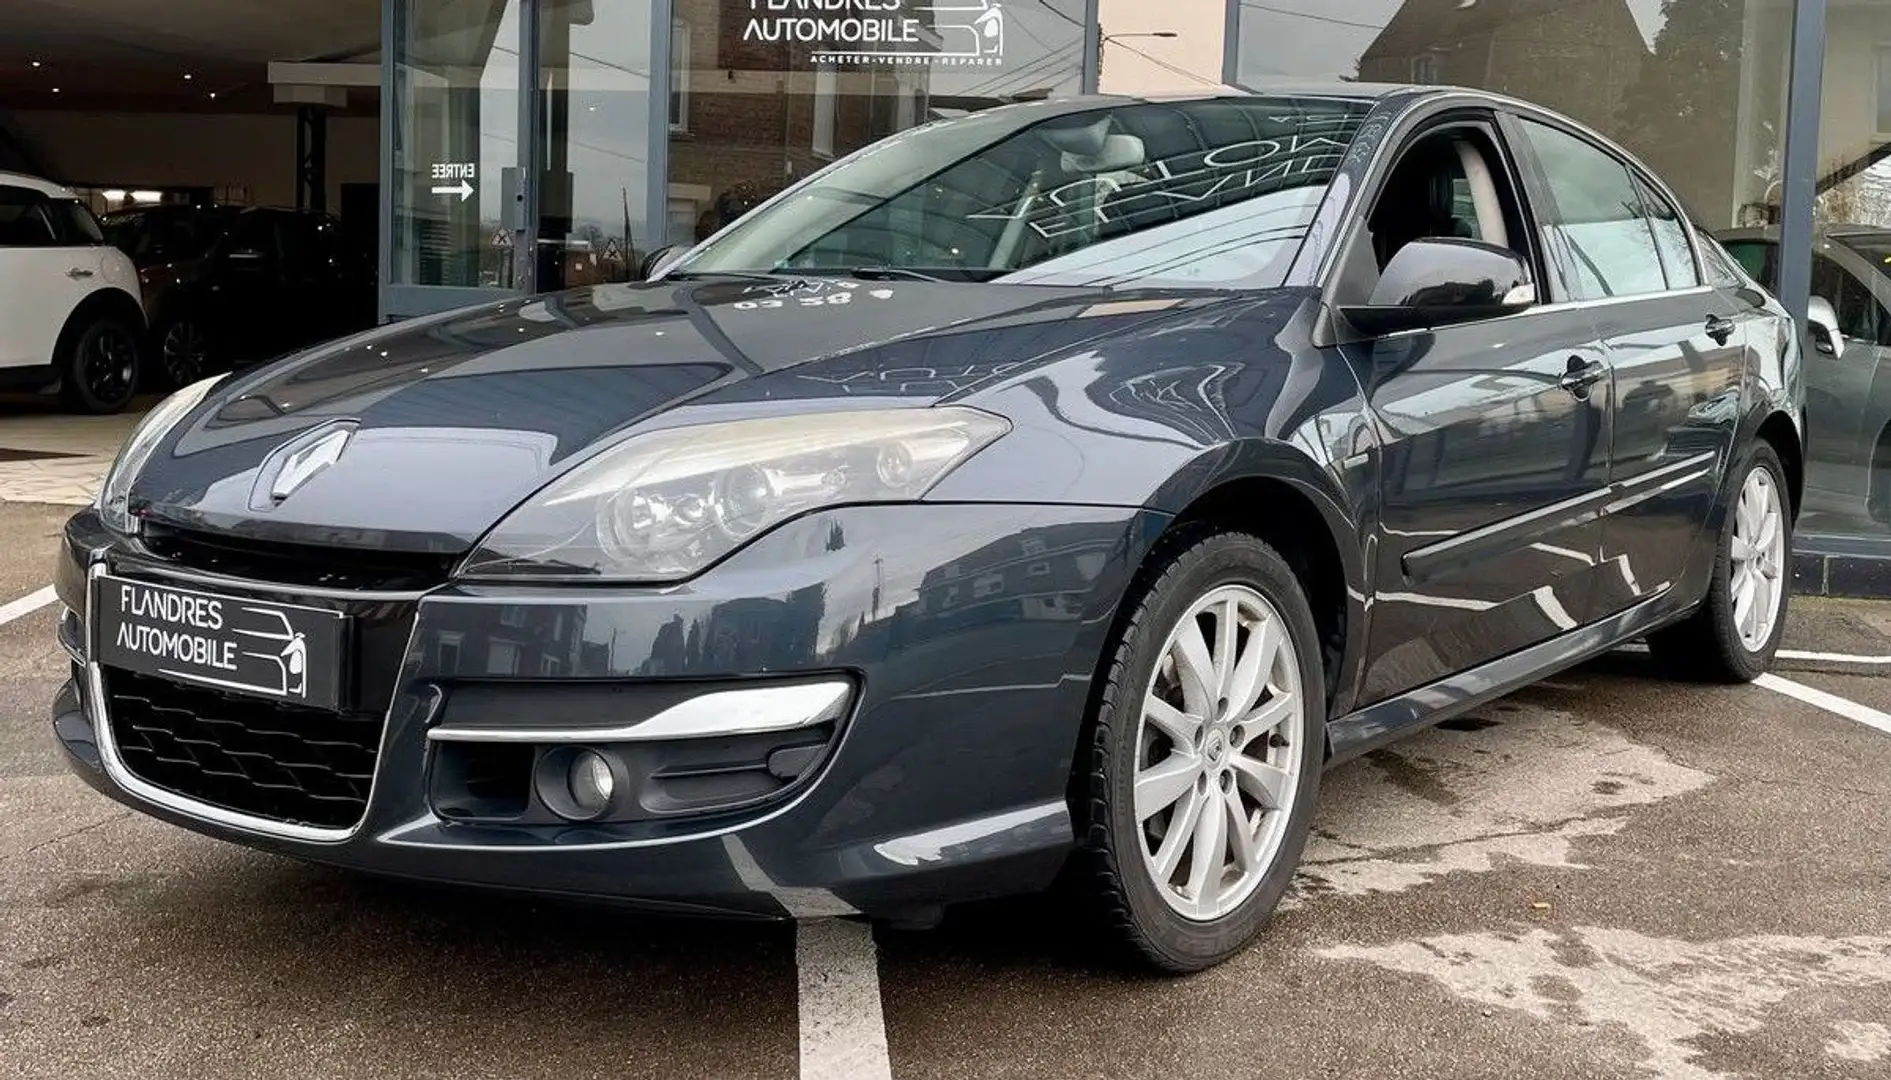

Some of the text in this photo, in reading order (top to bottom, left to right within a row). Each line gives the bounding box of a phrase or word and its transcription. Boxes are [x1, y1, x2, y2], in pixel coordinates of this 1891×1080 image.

[743, 18, 919, 42] AUTOMOBILE
[120, 584, 223, 630] FLANDRES
[116, 621, 238, 670] AUTOMOBILE
